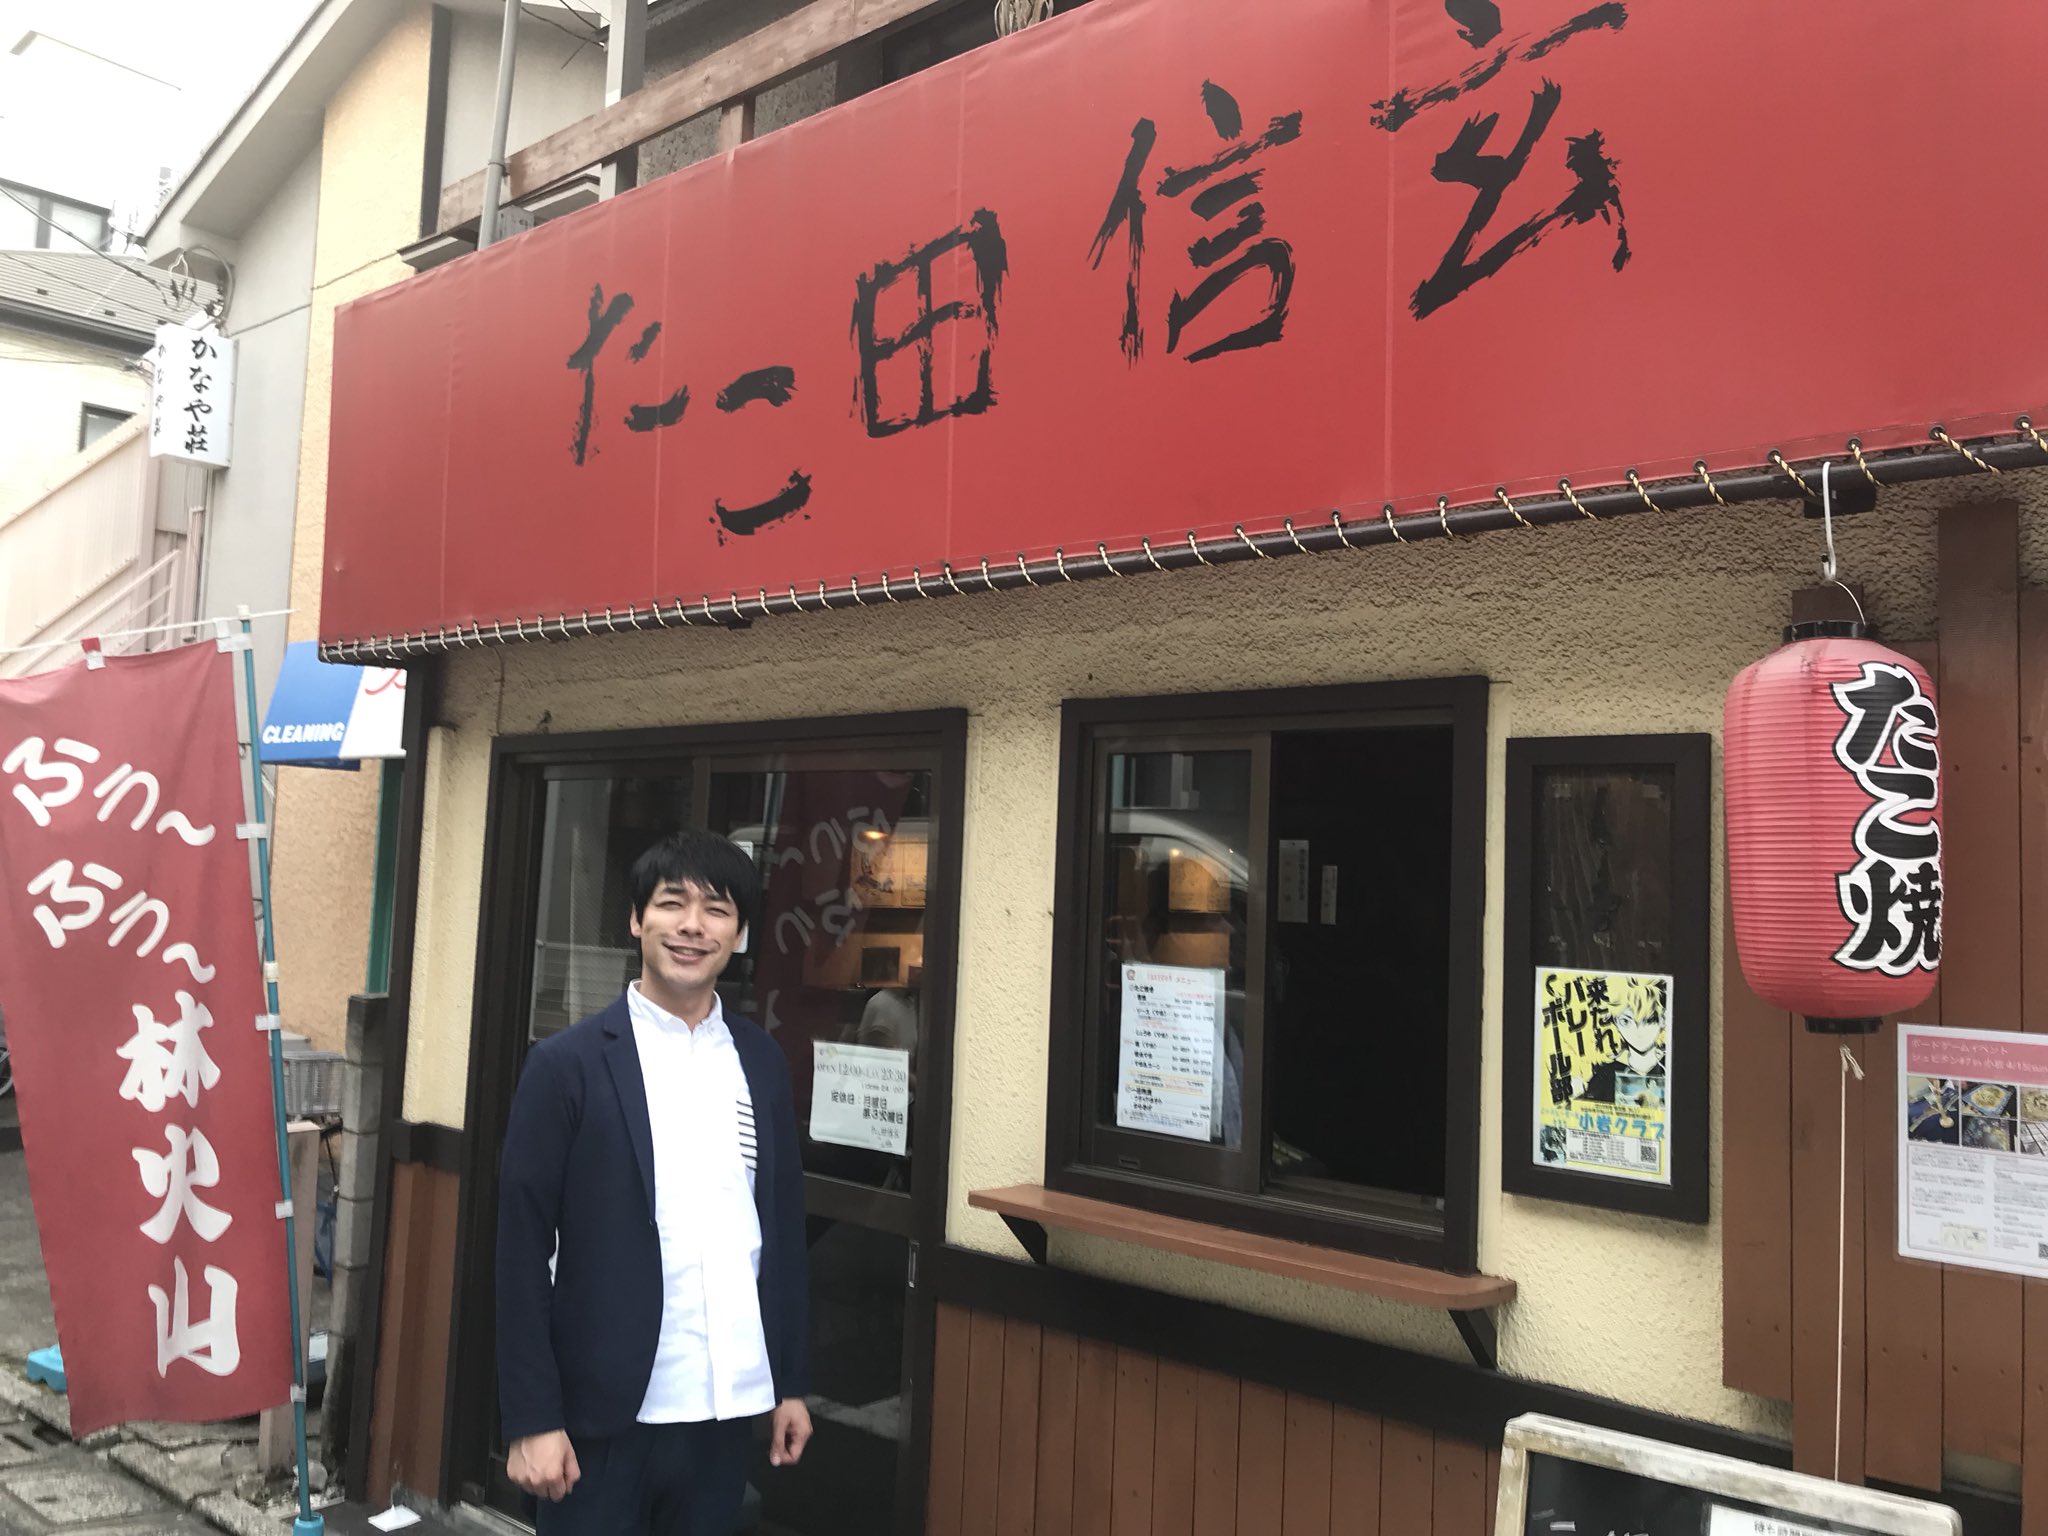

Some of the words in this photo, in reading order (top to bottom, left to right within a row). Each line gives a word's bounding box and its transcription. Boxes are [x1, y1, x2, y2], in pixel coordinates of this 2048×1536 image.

[567, 0, 1632, 547] たこ田信玄
[262, 721, 346, 745] CLEANING
[116, 990, 241, 1379] 林火山
